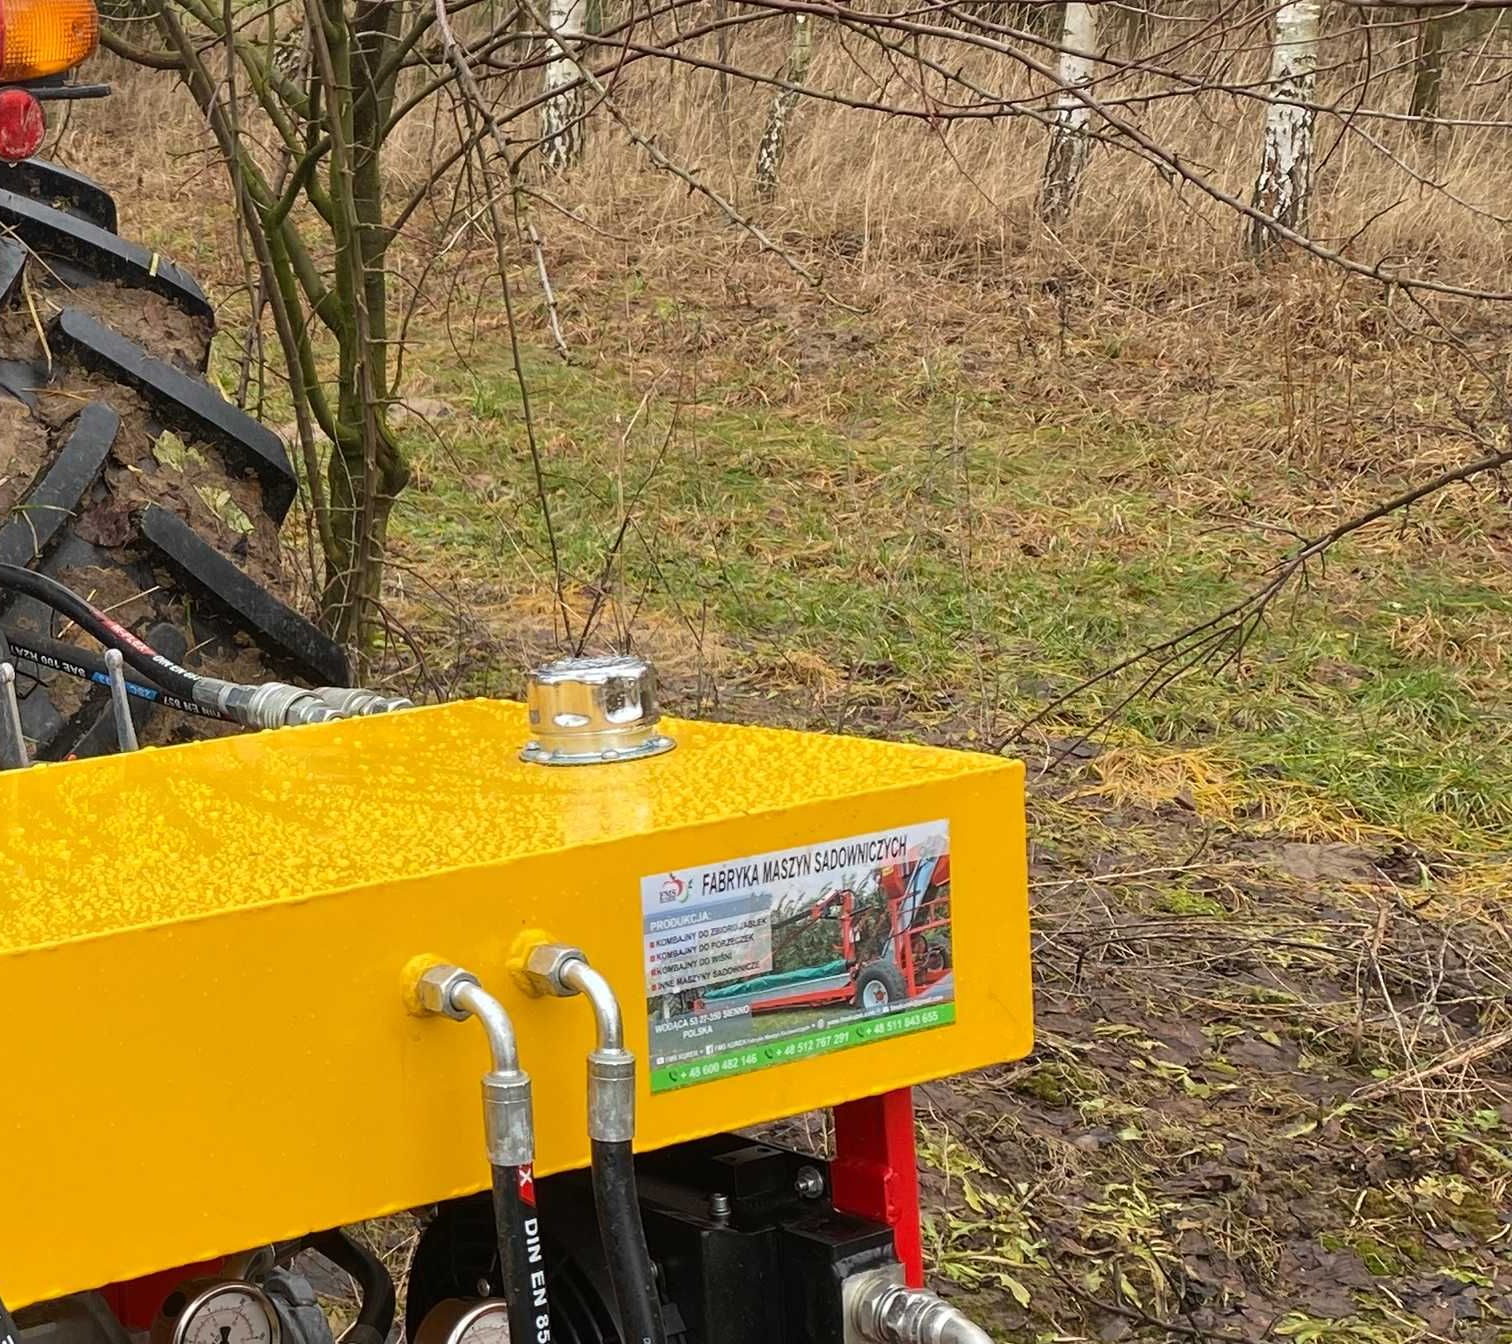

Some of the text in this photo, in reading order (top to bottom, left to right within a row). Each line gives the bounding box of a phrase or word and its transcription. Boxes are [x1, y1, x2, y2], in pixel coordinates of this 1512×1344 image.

[62, 661, 87, 679] SAE
[702, 833, 908, 897] FABRYKA MASZYN SADOWNICZYCH
[656, 932, 697, 947] KOMBAJNY
[698, 929, 710, 939] DO
[656, 945, 697, 960] KOMBAJNY
[698, 944, 710, 953] DO
[657, 959, 697, 976] KOMBAJNY
[699, 957, 710, 966] DO
[682, 1025, 714, 1040] POLSKA
[797, 1040, 813, 1052] 512
[522, 1216, 539, 1267] DIN
[530, 1272, 548, 1312] EN
